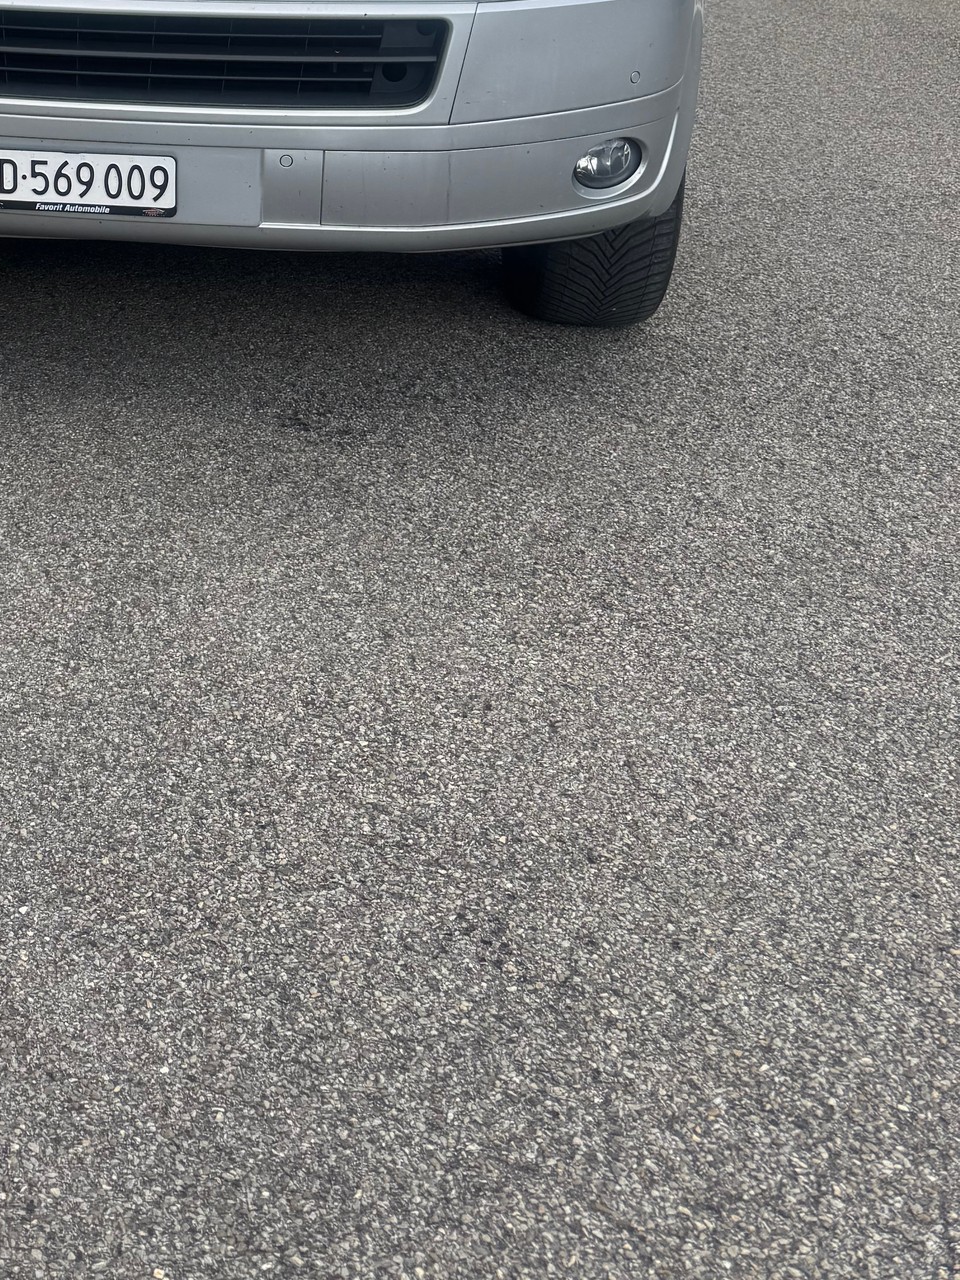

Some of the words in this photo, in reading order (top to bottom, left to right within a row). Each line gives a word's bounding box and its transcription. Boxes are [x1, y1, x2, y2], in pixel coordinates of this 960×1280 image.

[103, 163, 170, 203] 009
[35, 202, 63, 211] Favorit
[64, 204, 110, 214] Automobile
